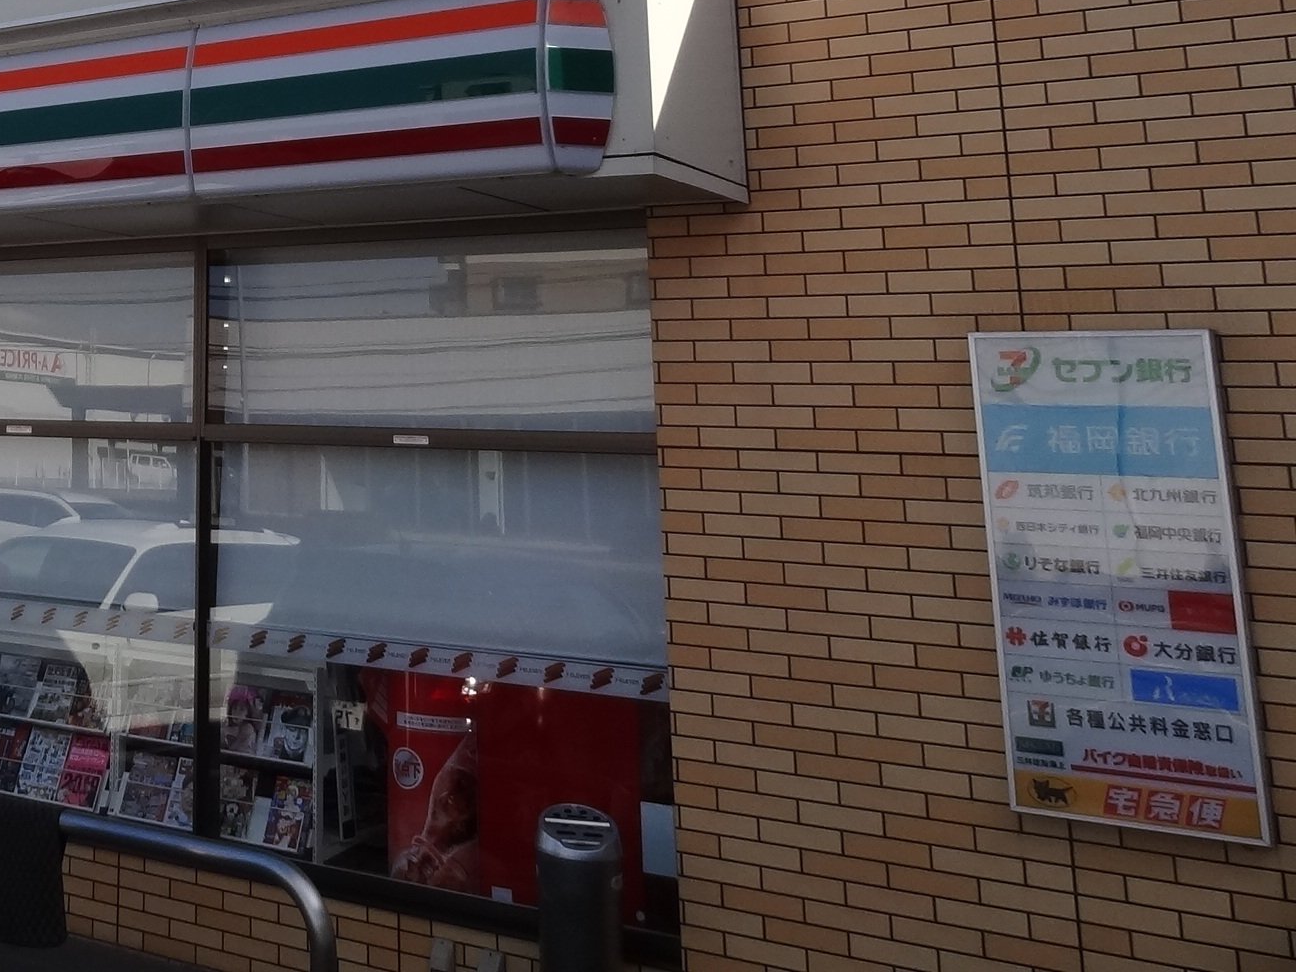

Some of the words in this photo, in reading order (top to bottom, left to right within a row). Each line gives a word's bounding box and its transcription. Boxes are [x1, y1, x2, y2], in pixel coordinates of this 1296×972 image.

[1052, 358, 1192, 384] セブン銀行
[1047, 425, 1202, 457] 福岡銀行
[1026, 483, 1095, 502] 筑邦銀行
[1132, 486, 1218, 505] 北九州銀行
[1015, 521, 1101, 536] 西日本シティ銀行
[1134, 525, 1222, 545] 福岡中央銀行
[1023, 555, 1101, 576] りそな銀行
[1141, 567, 1227, 585] 三井住友銀行
[1030, 630, 1113, 654] 佐賀銀行
[1153, 641, 1237, 665] 大分銀行
[1039, 670, 1116, 690] ゆうちょ銀行
[1065, 707, 1235, 744] 各種公共料金窓口
[1107, 785, 1224, 830] 宅急便
